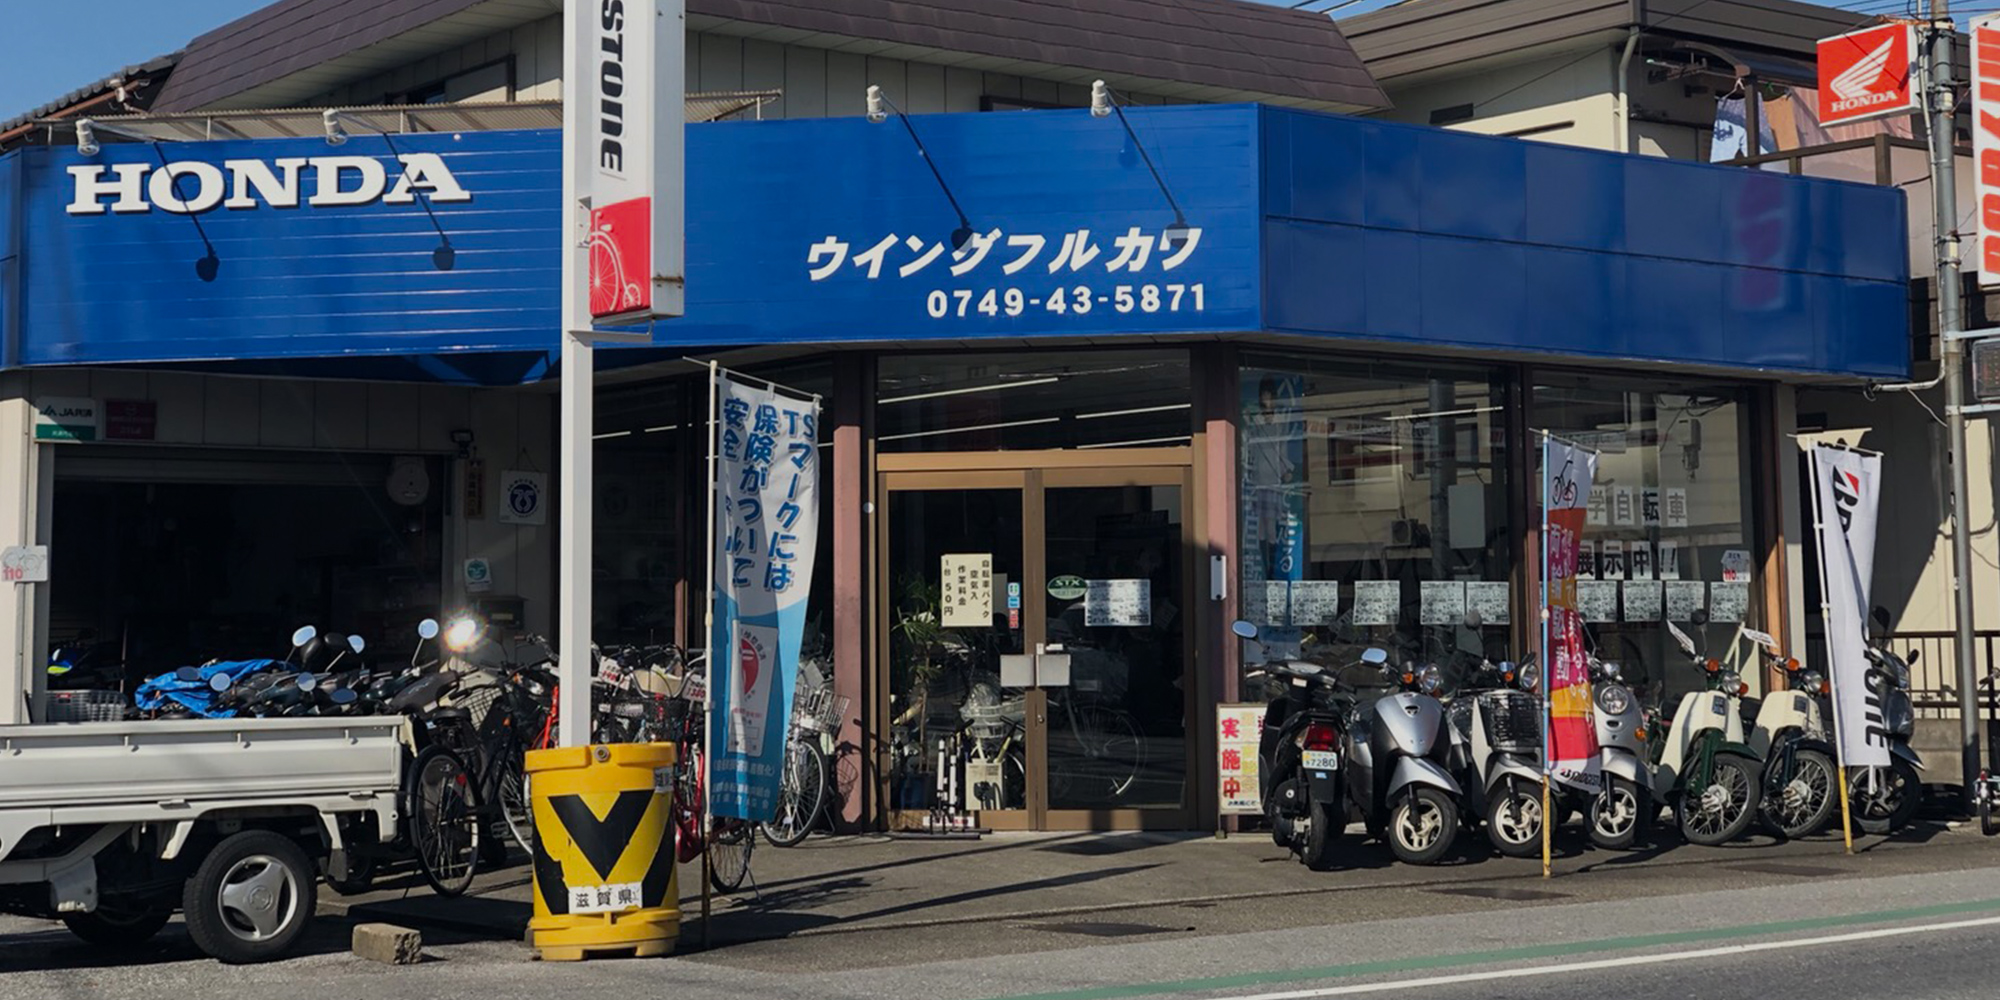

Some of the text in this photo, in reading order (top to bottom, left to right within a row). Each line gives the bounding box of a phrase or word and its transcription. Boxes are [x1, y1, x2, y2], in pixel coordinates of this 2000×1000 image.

[1831, 91, 1898, 113] HONDA
[66, 152, 471, 214] HONDA
[927, 283, 1205, 318] 0749-43-5871
[733, 404, 779, 587] 保険がついて
[764, 408, 815, 592] TSマークには
[1221, 716, 1241, 799] 実施中
[1311, 757, 1336, 768] 7280
[576, 887, 632, 908] 滋賀県
